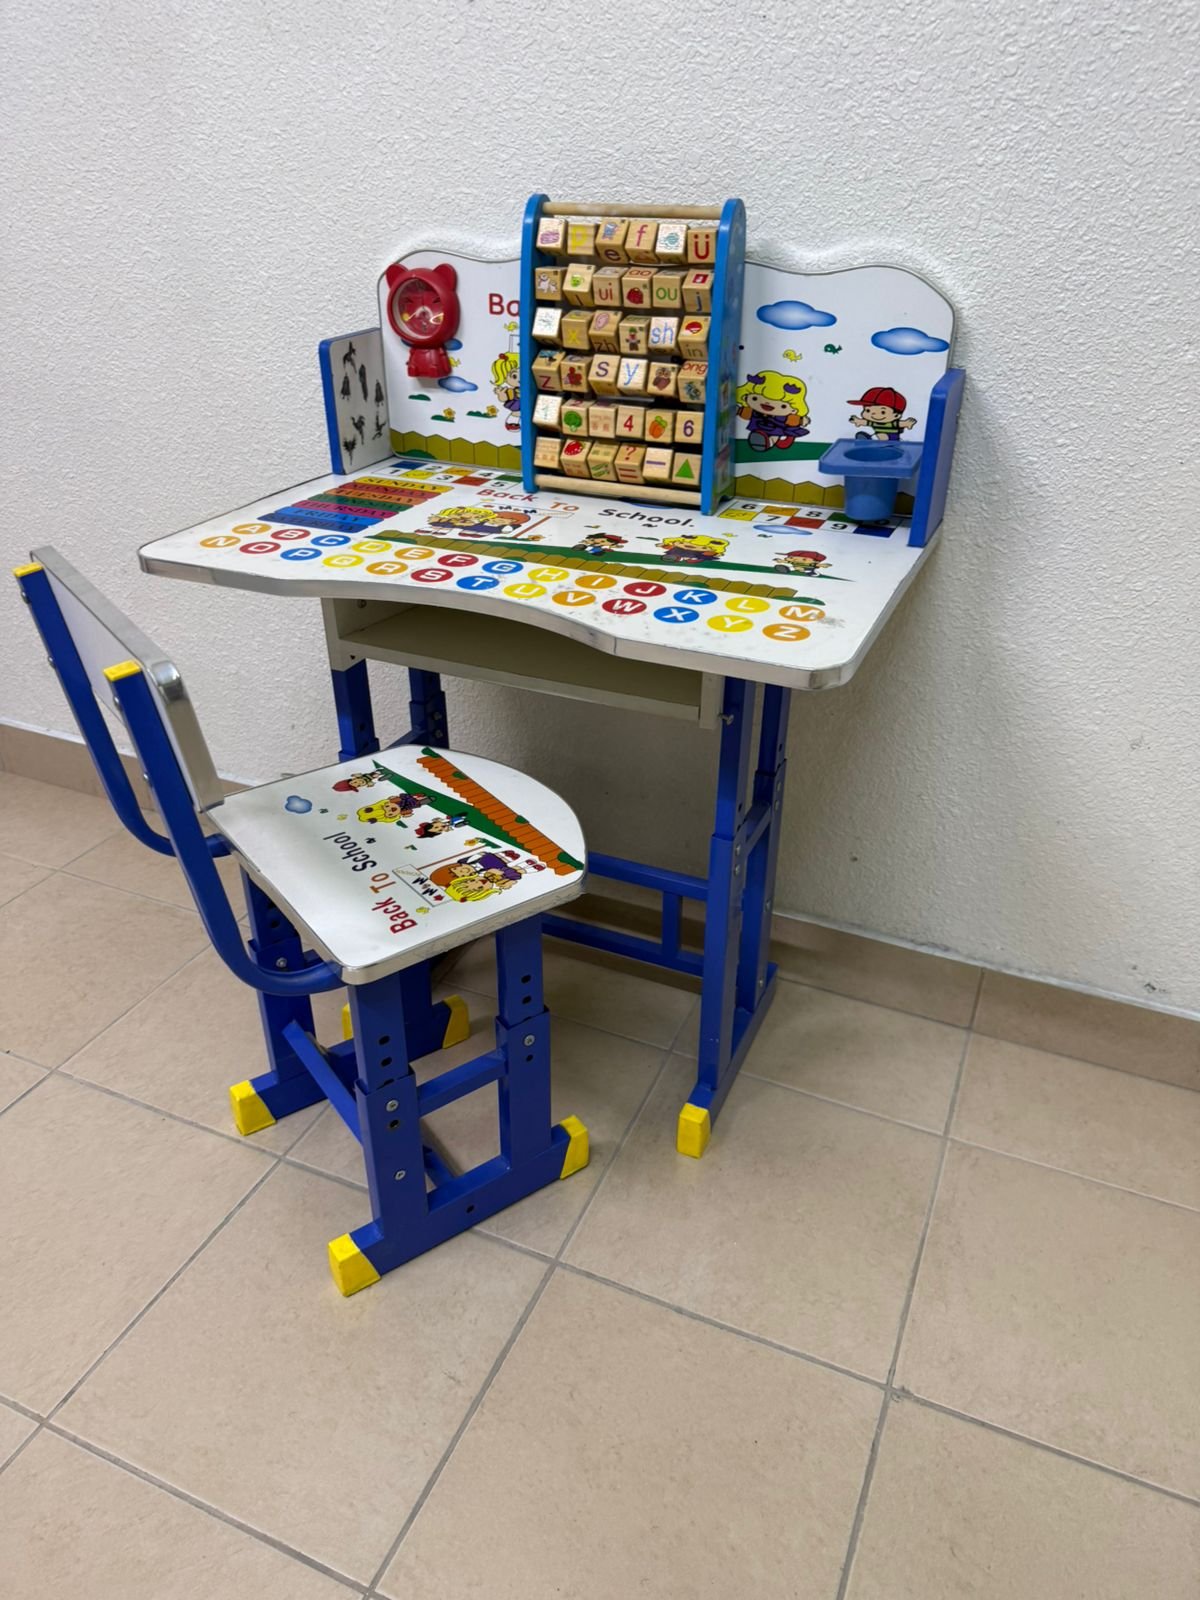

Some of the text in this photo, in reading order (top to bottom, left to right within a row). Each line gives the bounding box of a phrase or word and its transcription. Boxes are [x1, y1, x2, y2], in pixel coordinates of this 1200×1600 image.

[636, 224, 648, 247] f
[604, 249, 621, 261] e
[598, 282, 613, 300] ui
[656, 288, 678, 301] ou
[696, 292, 702, 312] j
[568, 330, 580, 344] x
[651, 322, 674, 344] sh
[688, 344, 703, 358] in
[682, 362, 708, 375] ong
[624, 414, 634, 432] 4
[682, 419, 694, 437] 6
[352, 483, 426, 497] MONDAY
[365, 478, 437, 490] SUNDAY
[336, 490, 413, 504] TUESDAY
[476, 488, 539, 502] Back
[550, 501, 580, 512] To
[294, 508, 359, 522] FRIDAY
[298, 501, 386, 516] THURSDAY
[805, 510, 822, 518] 8
[236, 525, 820, 620] A B C D E F G H I J K L M
[207, 537, 237, 546] N
[248, 543, 275, 552] O
[374, 562, 401, 573] R
[420, 570, 447, 580] S
[472, 578, 493, 587] T
[513, 585, 540, 596] U
[566, 592, 591, 603] V
[612, 600, 643, 612] W
[662, 608, 693, 621] X
[723, 617, 747, 628] Y
[773, 626, 802, 639] Z
[323, 831, 378, 872] School
[369, 872, 396, 894] To
[371, 896, 418, 934] Back
